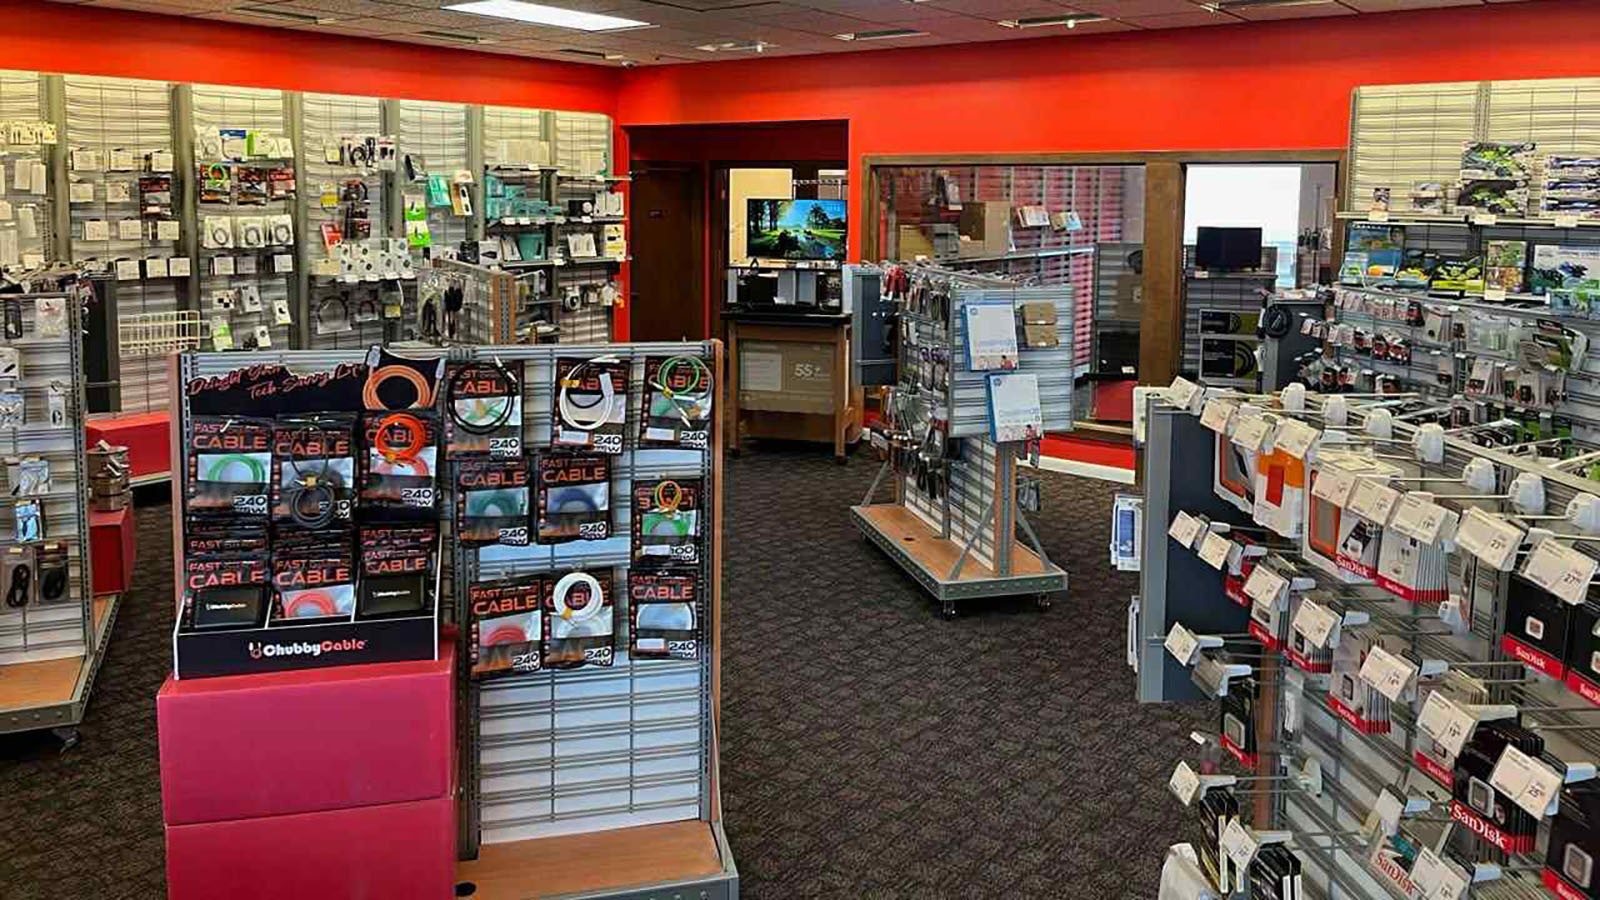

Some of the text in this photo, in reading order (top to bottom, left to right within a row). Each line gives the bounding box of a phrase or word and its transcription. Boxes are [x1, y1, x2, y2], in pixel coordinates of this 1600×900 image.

[448, 369, 479, 379] FST
[453, 380, 508, 395] CABL
[193, 435, 267, 449] CABLE
[594, 435, 622, 445] 240
[681, 431, 705, 441] 240
[276, 441, 349, 456] CABLE
[490, 439, 519, 448] 240
[460, 470, 526, 486] CABLE
[542, 466, 605, 483] CABLE
[402, 489, 432, 498] 240
[234, 496, 264, 506] 240
[320, 501, 349, 511] 20
[500, 528, 527, 538] 240
[580, 523, 605, 533] 240
[191, 540, 221, 549] FAST
[190, 561, 221, 571] FAST
[276, 559, 307, 570] FAST
[366, 557, 427, 574] CABLE
[1336, 555, 1371, 579] SanDisk
[189, 571, 265, 589] CABLE
[276, 568, 350, 586] CABLE
[473, 589, 500, 600] FAST
[632, 586, 694, 600] CABLE
[473, 594, 538, 615] CABLE
[545, 593, 610, 608] CBE
[262, 638, 365, 657] ChubbyCable
[670, 641, 695, 650] 240
[513, 652, 539, 666] 240
[586, 648, 611, 660] 240
[1515, 646, 1545, 670] SanDisk
[1452, 804, 1508, 850] SanDisk
[1375, 852, 1417, 896] SanDisk
